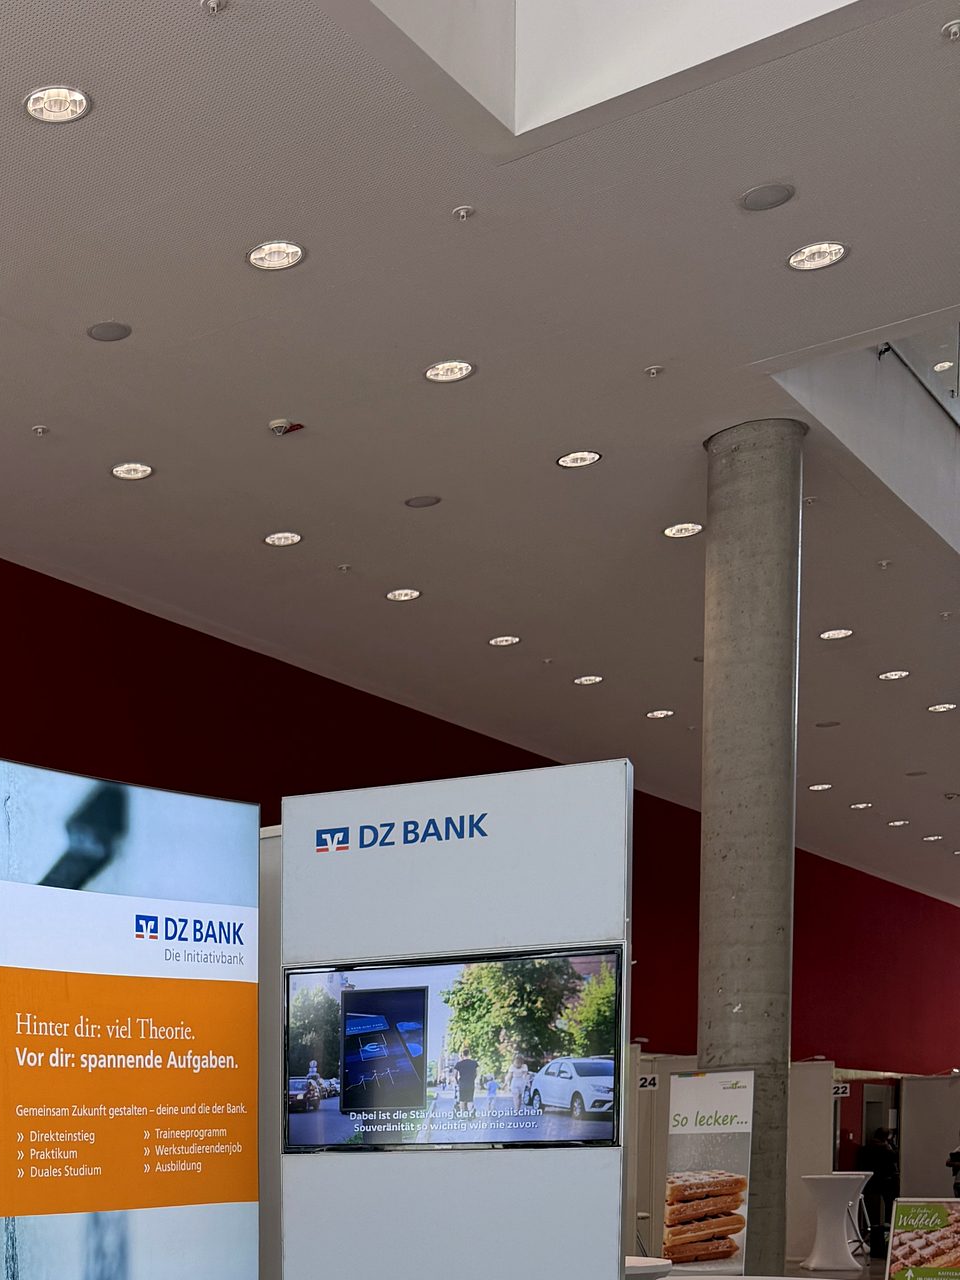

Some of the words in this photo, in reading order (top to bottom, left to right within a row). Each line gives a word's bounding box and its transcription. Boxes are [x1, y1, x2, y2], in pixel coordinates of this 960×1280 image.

[358, 822, 395, 849] DZ
[403, 813, 488, 845] BANK
[164, 917, 189, 942] DZ
[193, 919, 245, 946] BANK
[164, 948, 181, 962] Die
[183, 949, 245, 966] Initiativbank
[15, 1013, 70, 1038] Hinter
[74, 1016, 101, 1039] dir:
[106, 1017, 132, 1039] viel
[136, 1018, 195, 1040] Theorie.
[15, 1047, 45, 1067] Vor
[49, 1048, 75, 1068] dir:
[80, 1049, 163, 1073] spannende
[167, 1050, 239, 1074] Aufgaben.
[639, 1077, 657, 1088] 24
[832, 1086, 848, 1095] 22
[15, 1104, 70, 1117] Gemeinsam
[71, 1104, 107, 1117] Zukunft
[108, 1104, 148, 1119] gestalten
[156, 1103, 180, 1115] deine
[180, 1103, 196, 1115] und
[197, 1103, 210, 1115] die
[211, 1103, 225, 1114] der
[226, 1103, 247, 1114] Bank.
[349, 1111, 377, 1120] Dabei
[378, 1111, 391, 1119] ist
[392, 1110, 408, 1119] die
[409, 1110, 454, 1120] Stärkung
[456, 1109, 474, 1118] der
[475, 1108, 543, 1118] europäischen
[354, 1123, 415, 1132] Souveränität
[430, 1121, 467, 1131] wichtig
[469, 1121, 487, 1129] wie
[490, 1121, 505, 1129] nie
[507, 1121, 538, 1129] zuvor.
[672, 1113, 689, 1128] So
[29, 1130, 96, 1143] Direkteinstieg
[154, 1127, 227, 1140] Traineeprogramm
[29, 1148, 78, 1160] Praktikum
[154, 1143, 243, 1156] Werkstudierendenjob
[30, 1165, 62, 1178] Duales
[64, 1164, 102, 1177] Studium
[155, 1161, 202, 1173] Ausbildung
[898, 1213, 942, 1228] Waffeln
